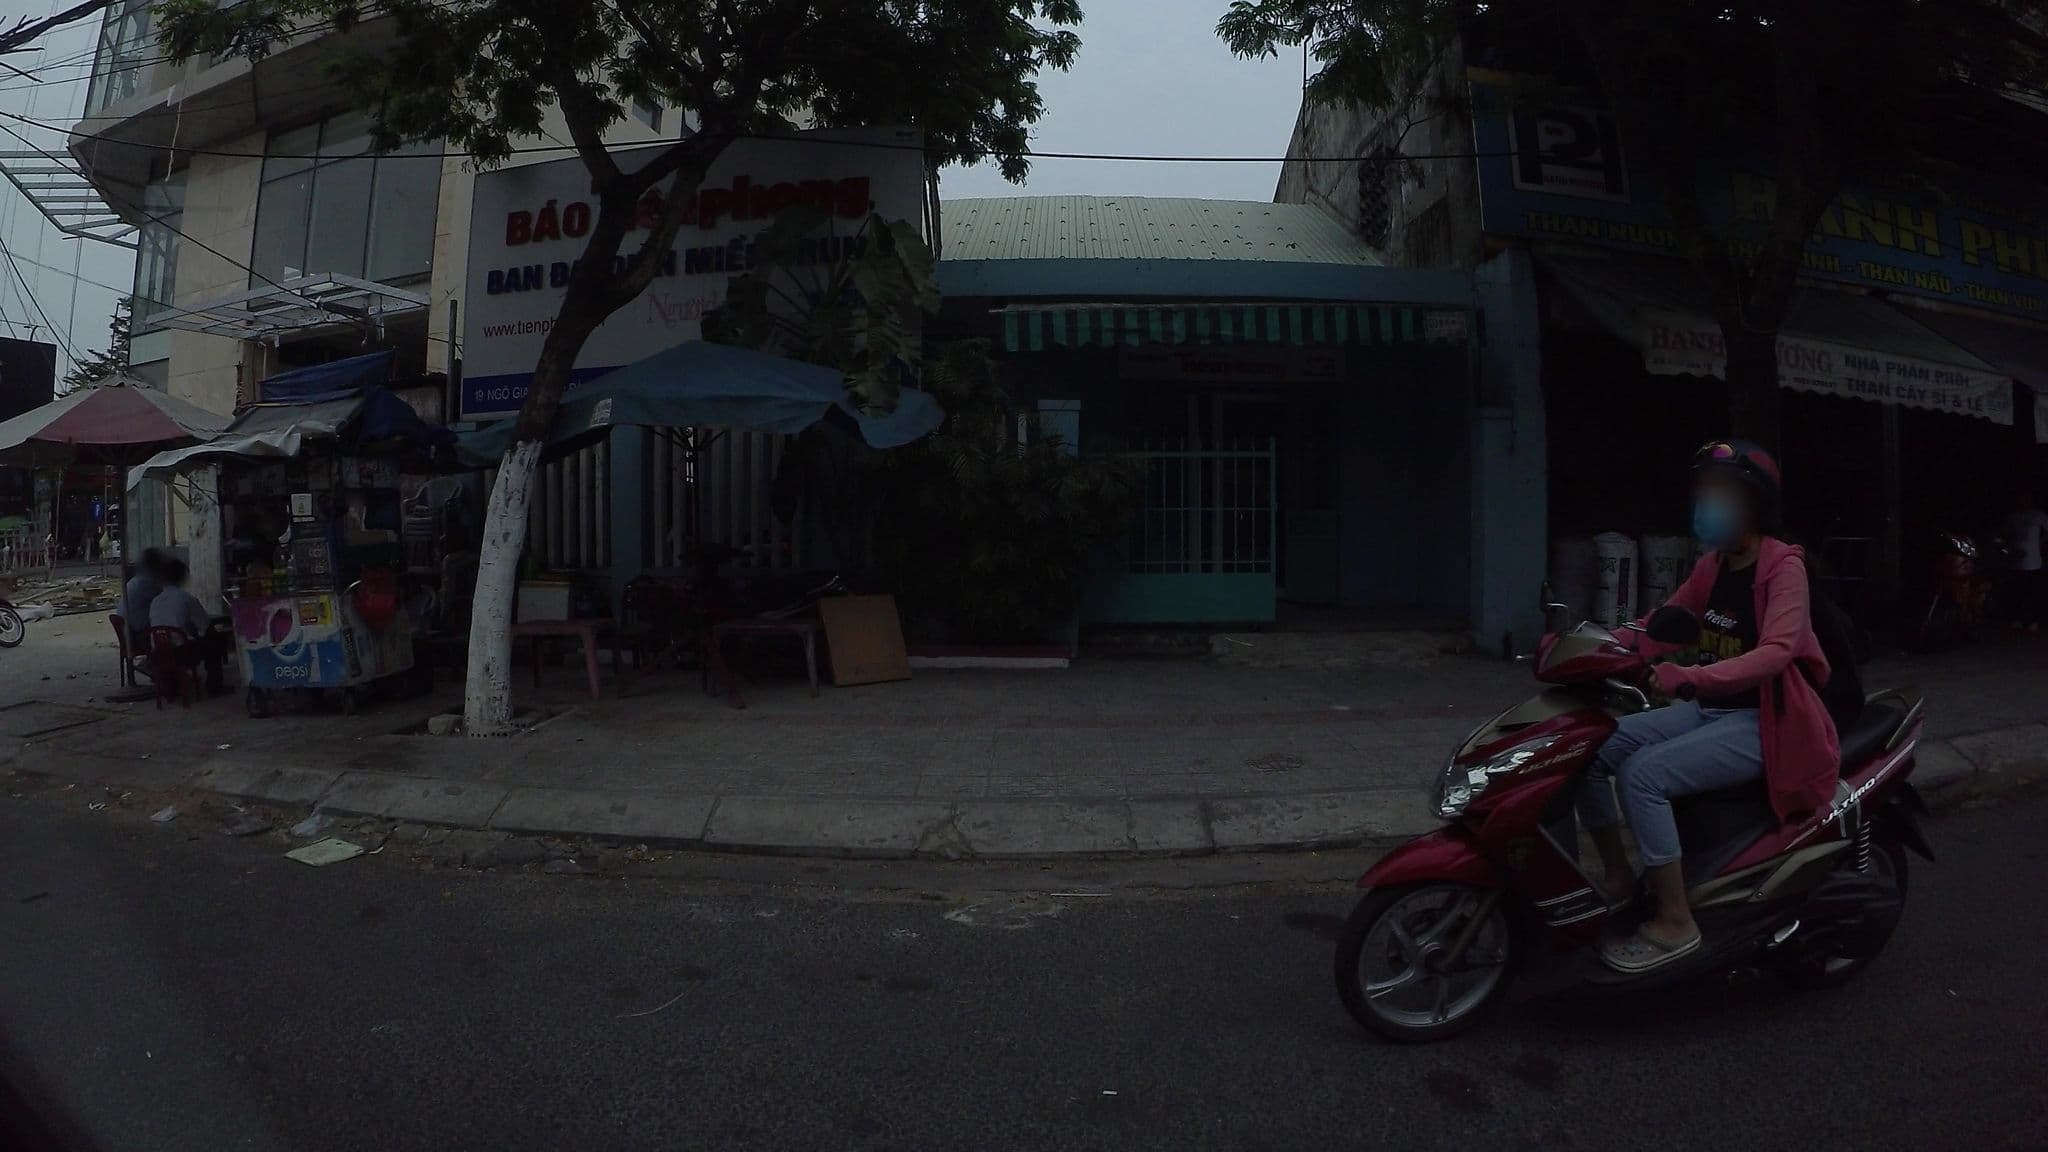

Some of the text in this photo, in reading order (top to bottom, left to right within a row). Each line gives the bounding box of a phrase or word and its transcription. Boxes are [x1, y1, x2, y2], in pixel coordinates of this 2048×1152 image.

[505, 199, 590, 246] BÁO
[486, 264, 543, 295] BAN
[1846, 377, 1891, 398] THAN
[273, 663, 310, 681] pepsi
